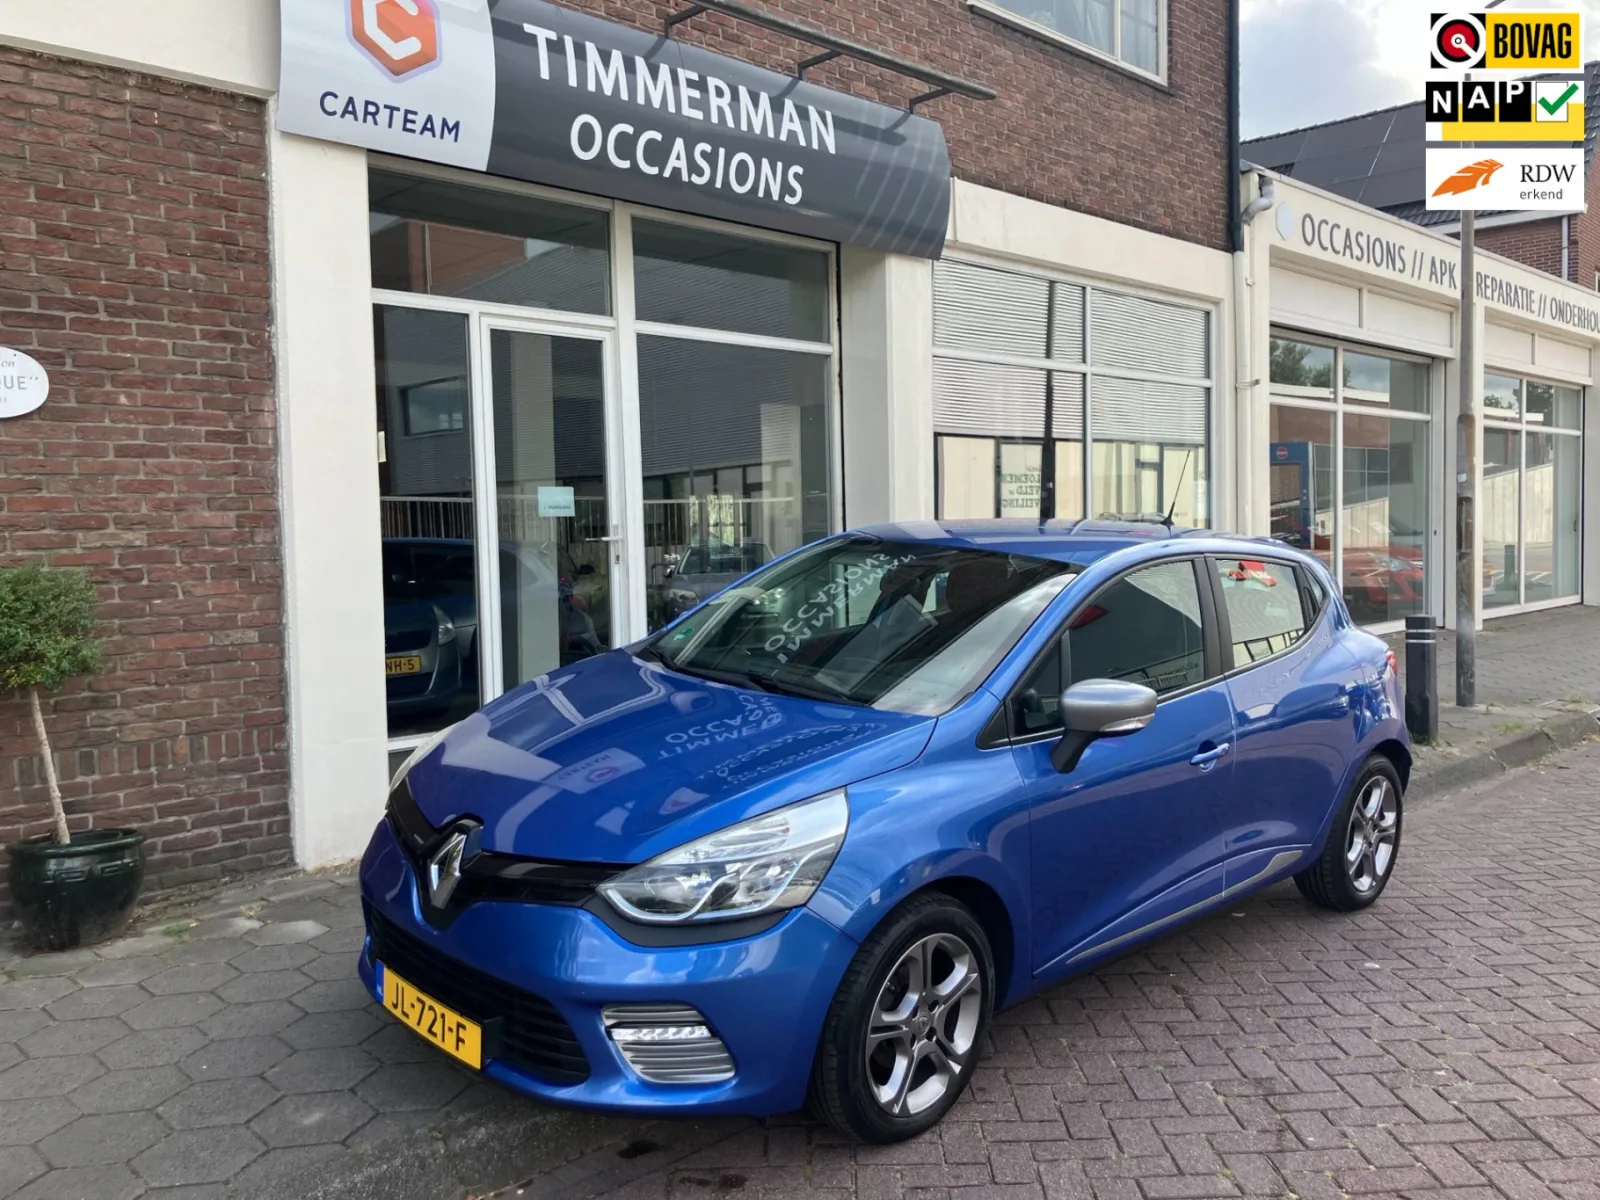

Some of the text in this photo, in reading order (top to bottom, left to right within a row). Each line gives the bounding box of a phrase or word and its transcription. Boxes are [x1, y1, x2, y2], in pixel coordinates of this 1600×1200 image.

[319, 91, 460, 143] CARTEAM
[523, 22, 836, 155] TIMMERMAN
[570, 113, 804, 205] OCCASIONS
[1301, 213, 1406, 274] OCCASIONS
[1429, 256, 1457, 290] APK
[1476, 271, 1535, 314] REPARATIE
[391, 982, 467, 1052] JL-721-F
